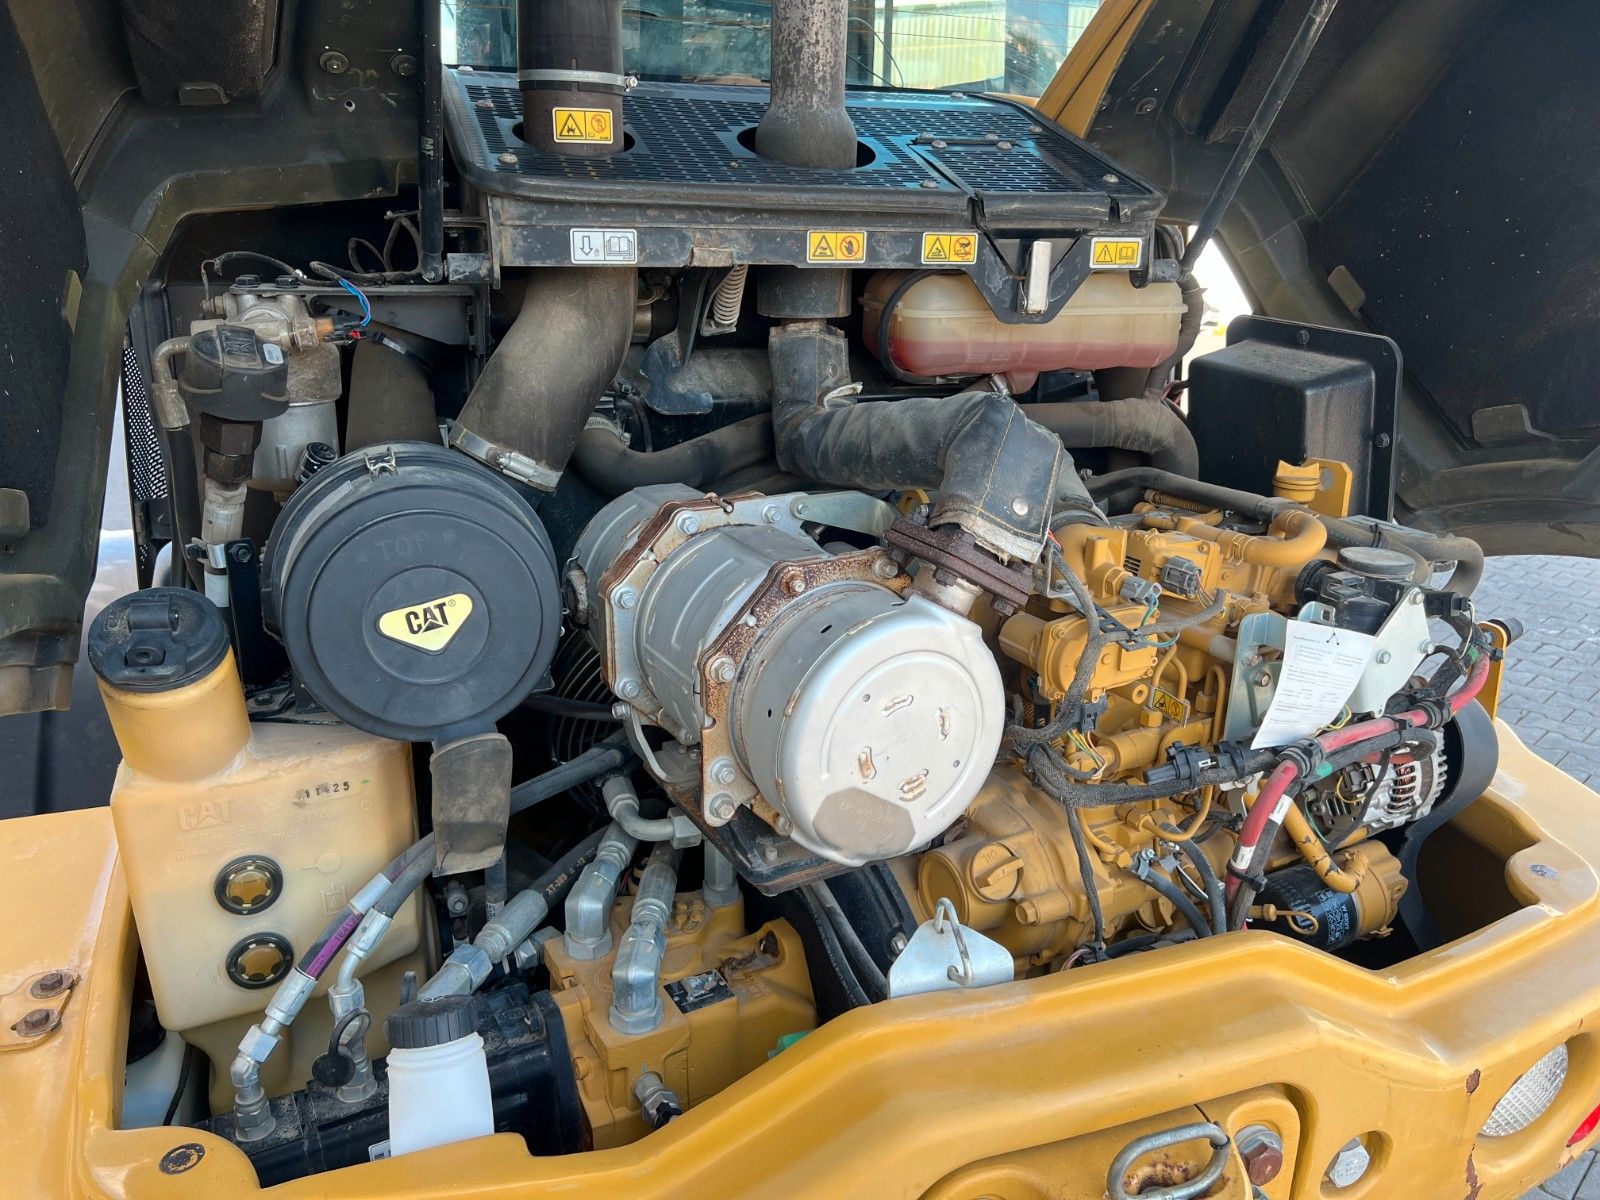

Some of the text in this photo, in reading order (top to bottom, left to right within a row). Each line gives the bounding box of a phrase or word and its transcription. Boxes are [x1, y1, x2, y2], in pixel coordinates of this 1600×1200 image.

[375, 532, 432, 561] TOP
[405, 601, 449, 635] CAT
[177, 798, 232, 832] CAT
